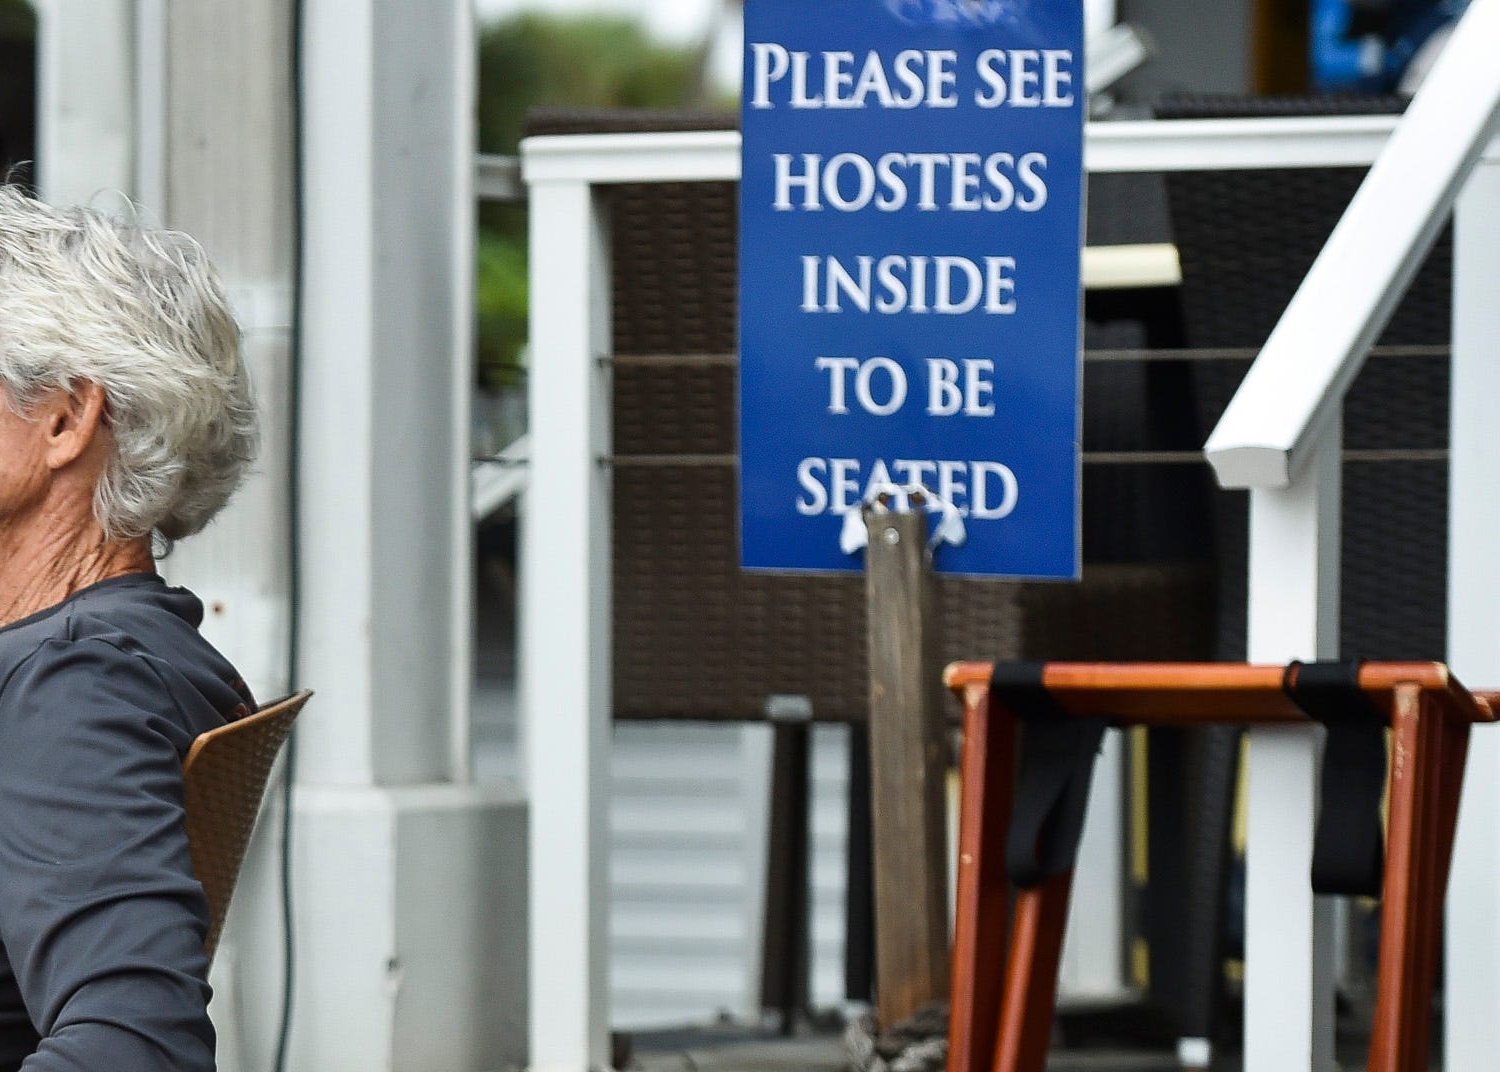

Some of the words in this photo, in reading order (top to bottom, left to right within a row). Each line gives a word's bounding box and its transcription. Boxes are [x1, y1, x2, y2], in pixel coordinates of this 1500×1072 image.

[751, 42, 958, 109] PLEASE
[974, 48, 1074, 108] SEE
[773, 152, 1048, 212] HOSTESS
[801, 255, 1017, 315] INSIDE
[815, 356, 908, 416] TO
[927, 358, 995, 417] BE
[796, 457, 1019, 520] SEATED
